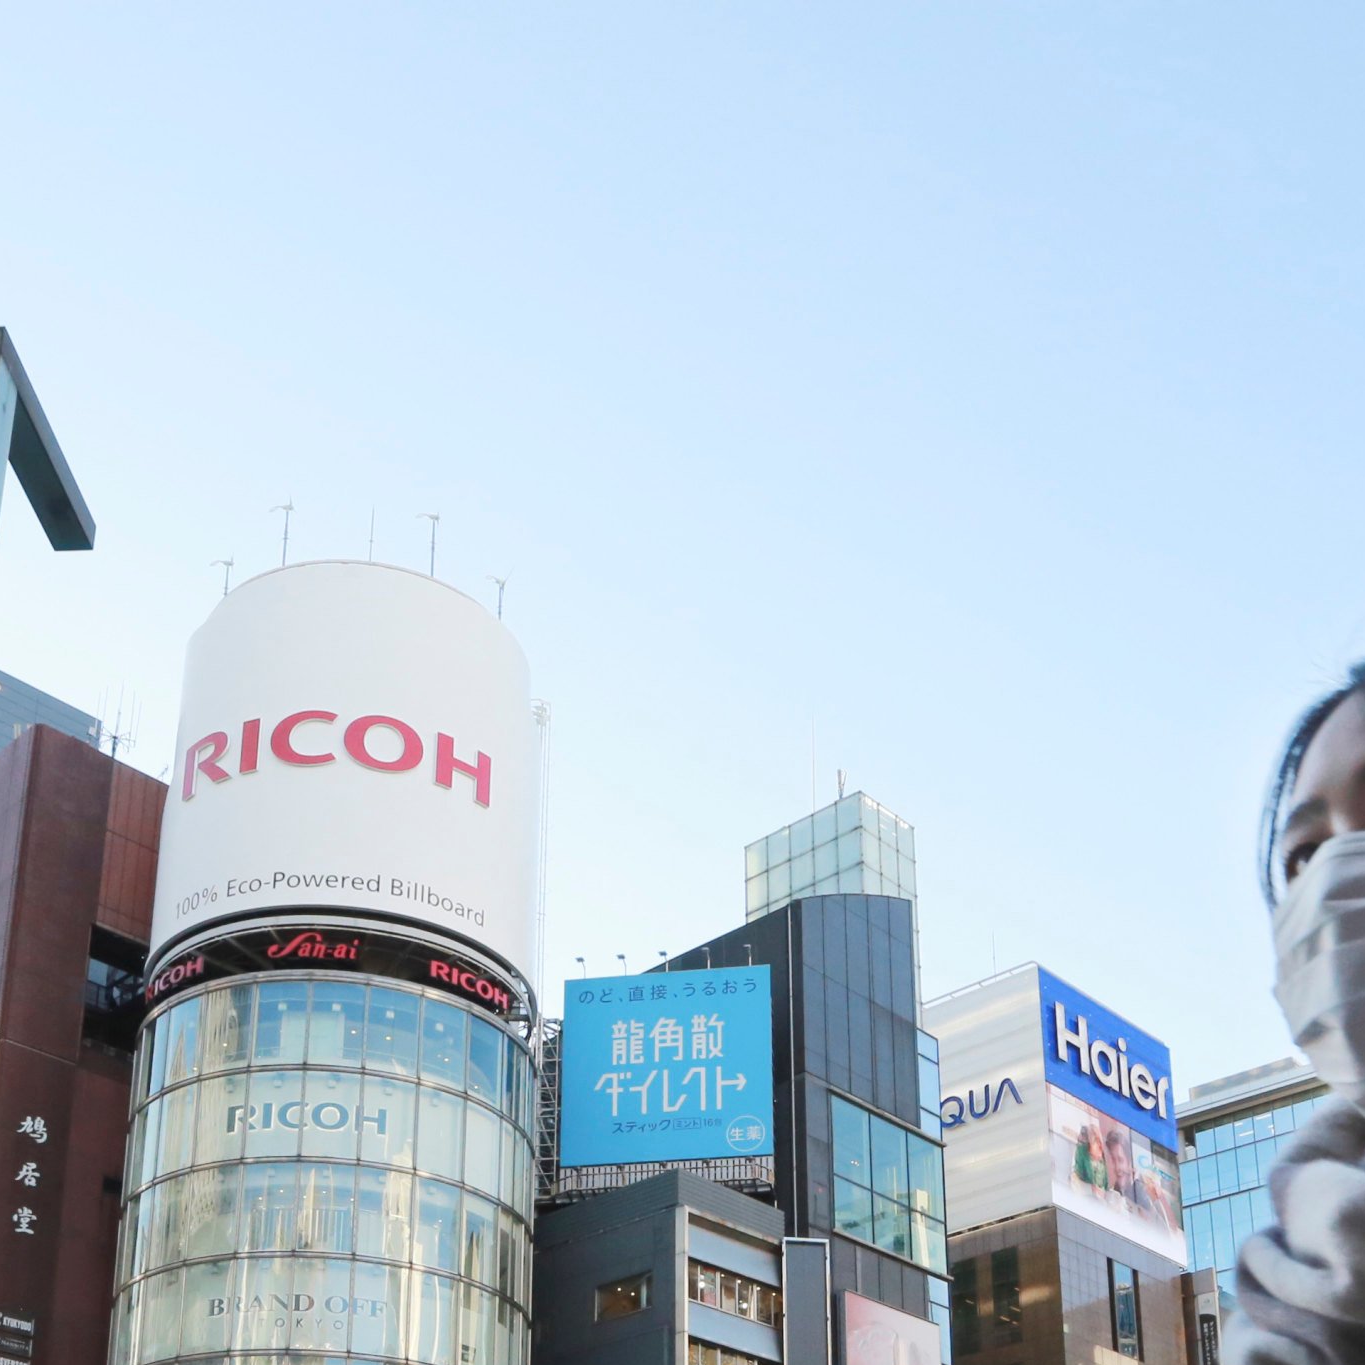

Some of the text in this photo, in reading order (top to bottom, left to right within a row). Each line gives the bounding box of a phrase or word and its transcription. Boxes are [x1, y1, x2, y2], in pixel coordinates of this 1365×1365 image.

[182, 709, 492, 809] RICOH
[175, 870, 485, 928] 100% Eco-Powered Billboard
[268, 931, 361, 960] San-ai
[145, 956, 205, 1001] RICOH
[430, 960, 509, 1010] RICOH
[578, 977, 758, 1005] のど、直接、うるおう
[611, 1012, 726, 1066] 龍角散
[1054, 1000, 1170, 1120] Haier
[593, 1065, 748, 1117] ダイレクト
[226, 1101, 388, 1136] RICOH
[611, 1119, 672, 1135] スティック
[729, 1126, 762, 1142] 生薬
[12, 1115, 48, 1235] 鳩居堂
[207, 1293, 388, 1319] BRAND OFF
[257, 1317, 345, 1330] TOKYO
